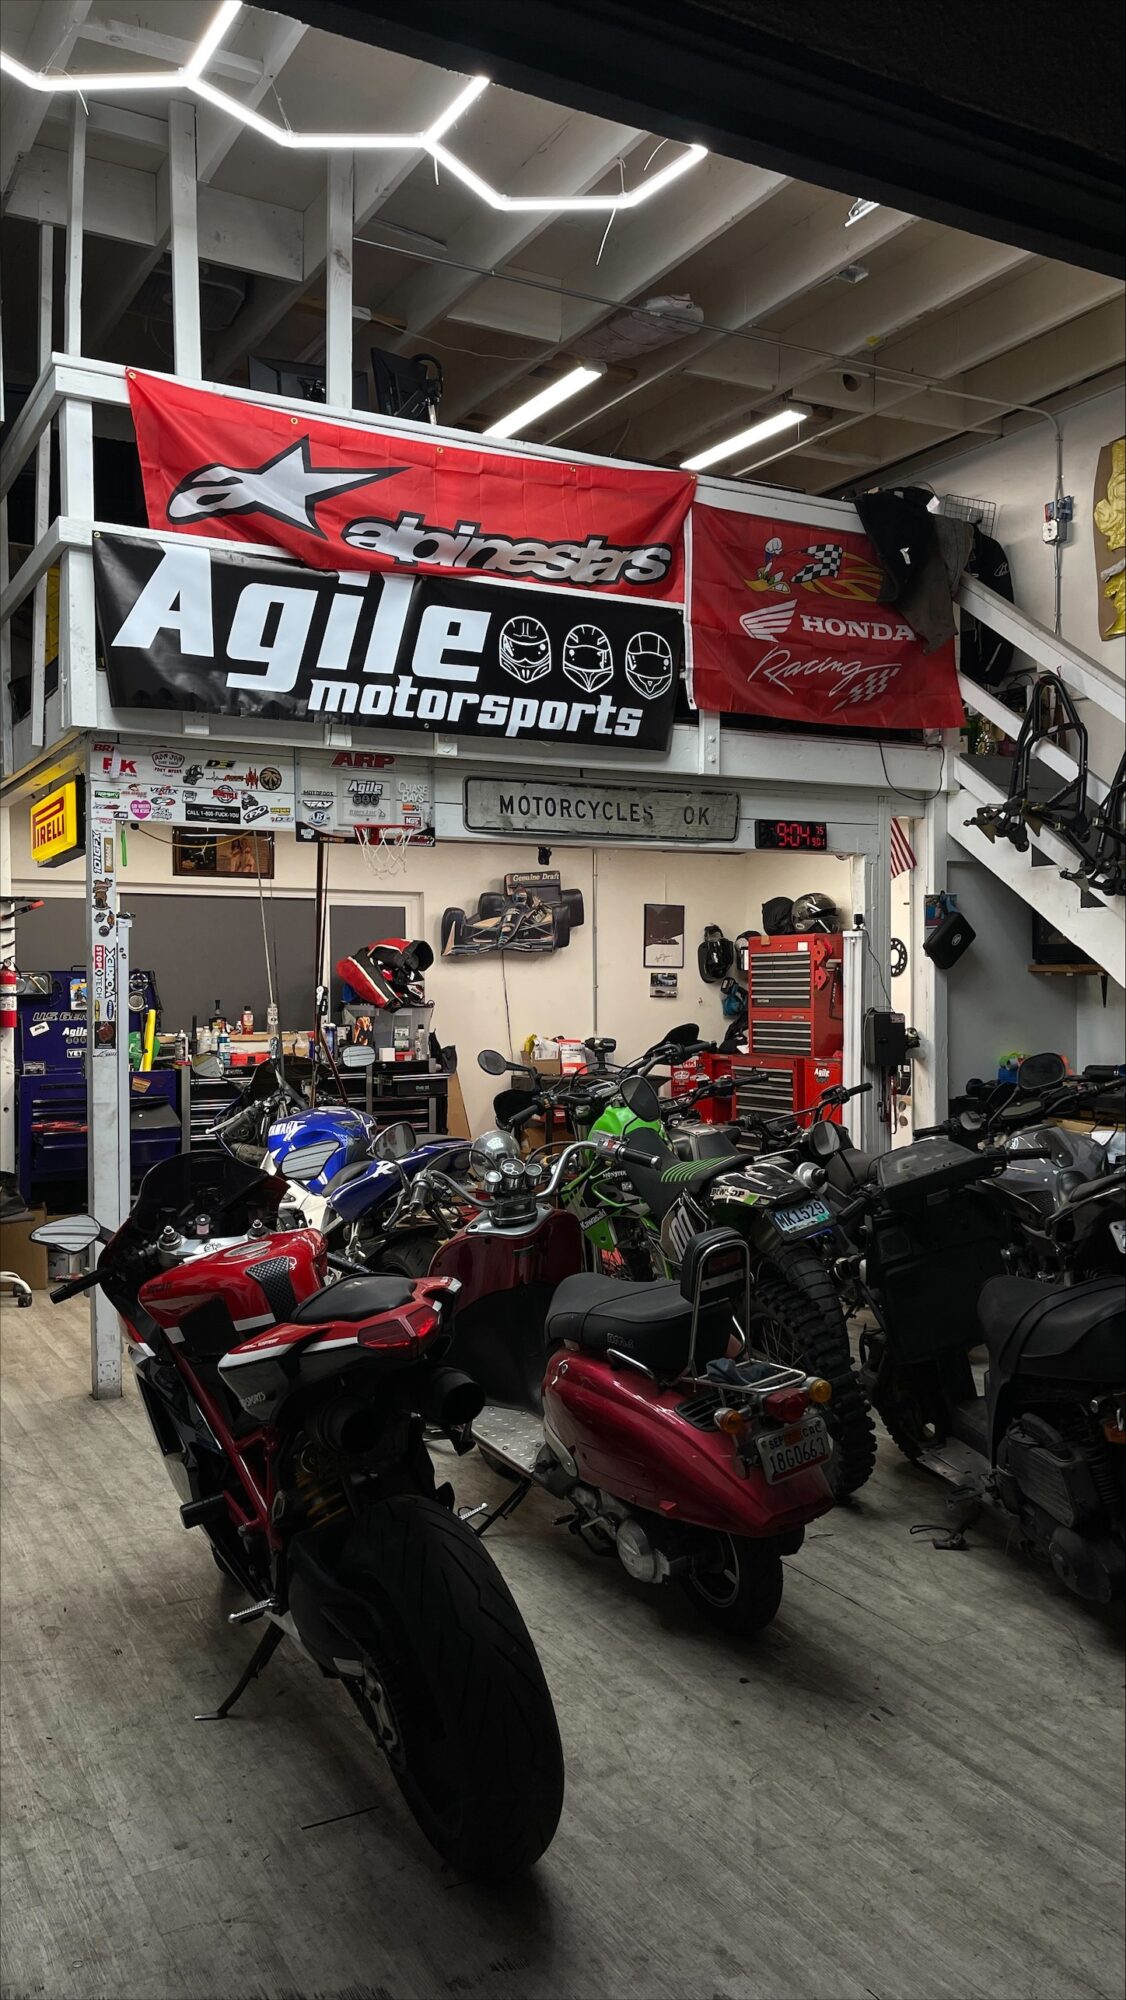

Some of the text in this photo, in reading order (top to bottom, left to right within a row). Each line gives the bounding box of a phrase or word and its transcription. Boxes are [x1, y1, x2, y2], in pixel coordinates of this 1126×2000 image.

[341, 513, 673, 585] alpinestars
[111, 541, 493, 693] Agile
[799, 614, 917, 641] HONDA
[747, 646, 901, 698] Racing
[307, 678, 643, 738] motorsports
[331, 752, 396, 768] ARP
[150, 786, 179, 796] VERTEX
[349, 781, 383, 794] Agile
[398, 781, 429, 793] CHASE
[402, 790, 426, 802] BAYS
[500, 795, 710, 825] MOTORCYCLES OK
[32, 796, 65, 849] PIRELLI
[776, 822, 811, 847] 9:04
[512, 873, 560, 882] Genuine Draft
[95, 946, 104, 969] STOP
[95, 977, 103, 998] TECH
[579, 1209, 607, 1230] Kawasaki
[776, 1201, 826, 1229] MK1529
[769, 1437, 784, 1450] SEP
